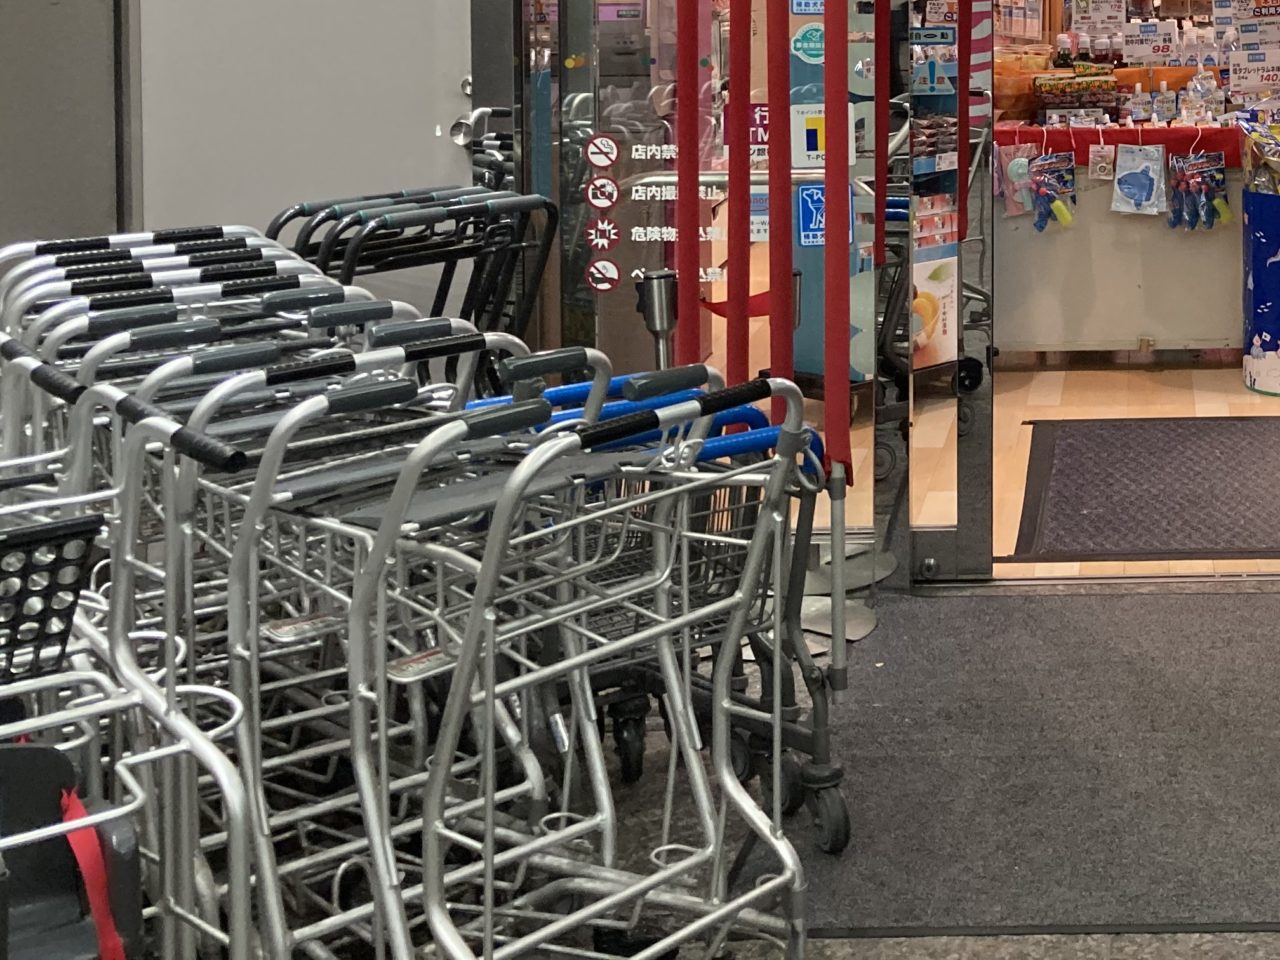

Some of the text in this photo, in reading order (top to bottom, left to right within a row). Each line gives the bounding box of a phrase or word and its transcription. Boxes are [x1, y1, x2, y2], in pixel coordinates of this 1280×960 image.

[1152, 45, 1170, 53] 98
[1260, 74, 1279, 82] 140
[631, 144, 679, 159] 店内禁
